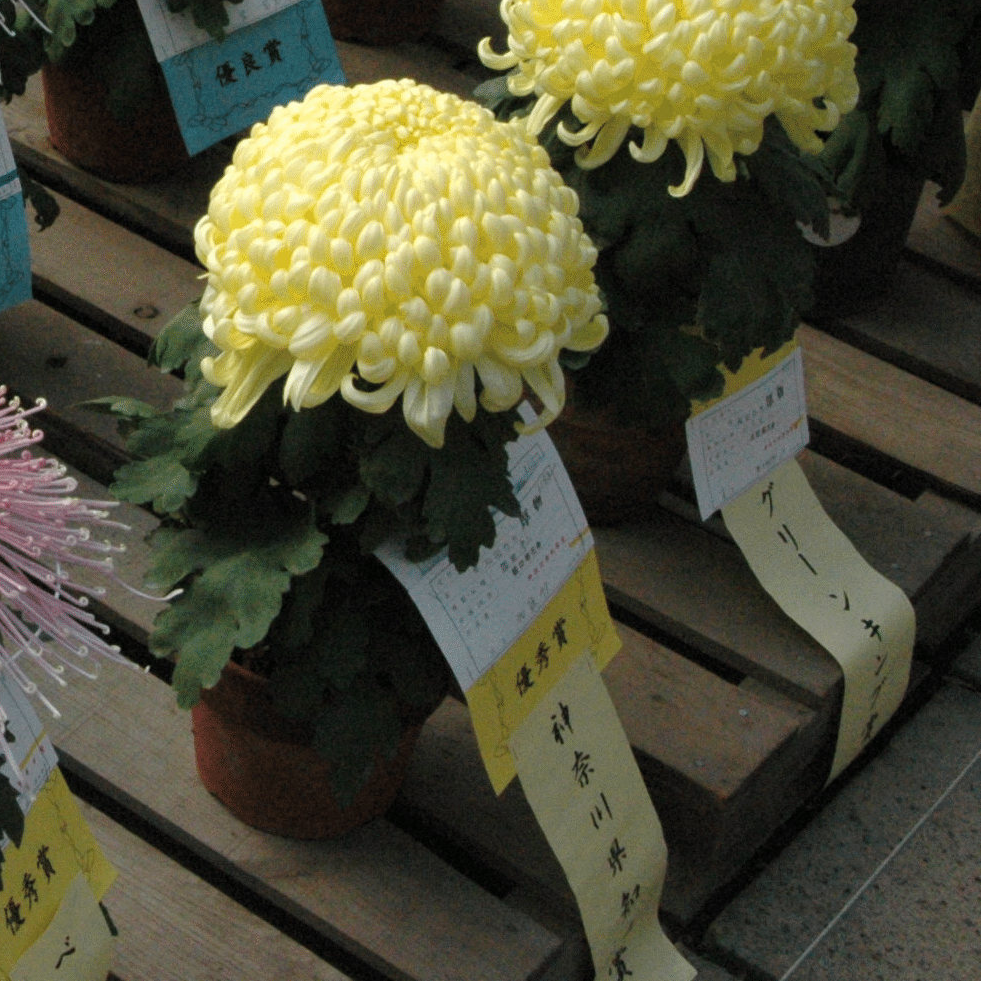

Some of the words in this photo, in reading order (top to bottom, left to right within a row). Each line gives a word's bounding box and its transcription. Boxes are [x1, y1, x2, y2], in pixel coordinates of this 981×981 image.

[214, 38, 284, 88] 優良賞
[514, 617, 570, 698] 優秀賞
[3, 844, 56, 936] 優秀賞
